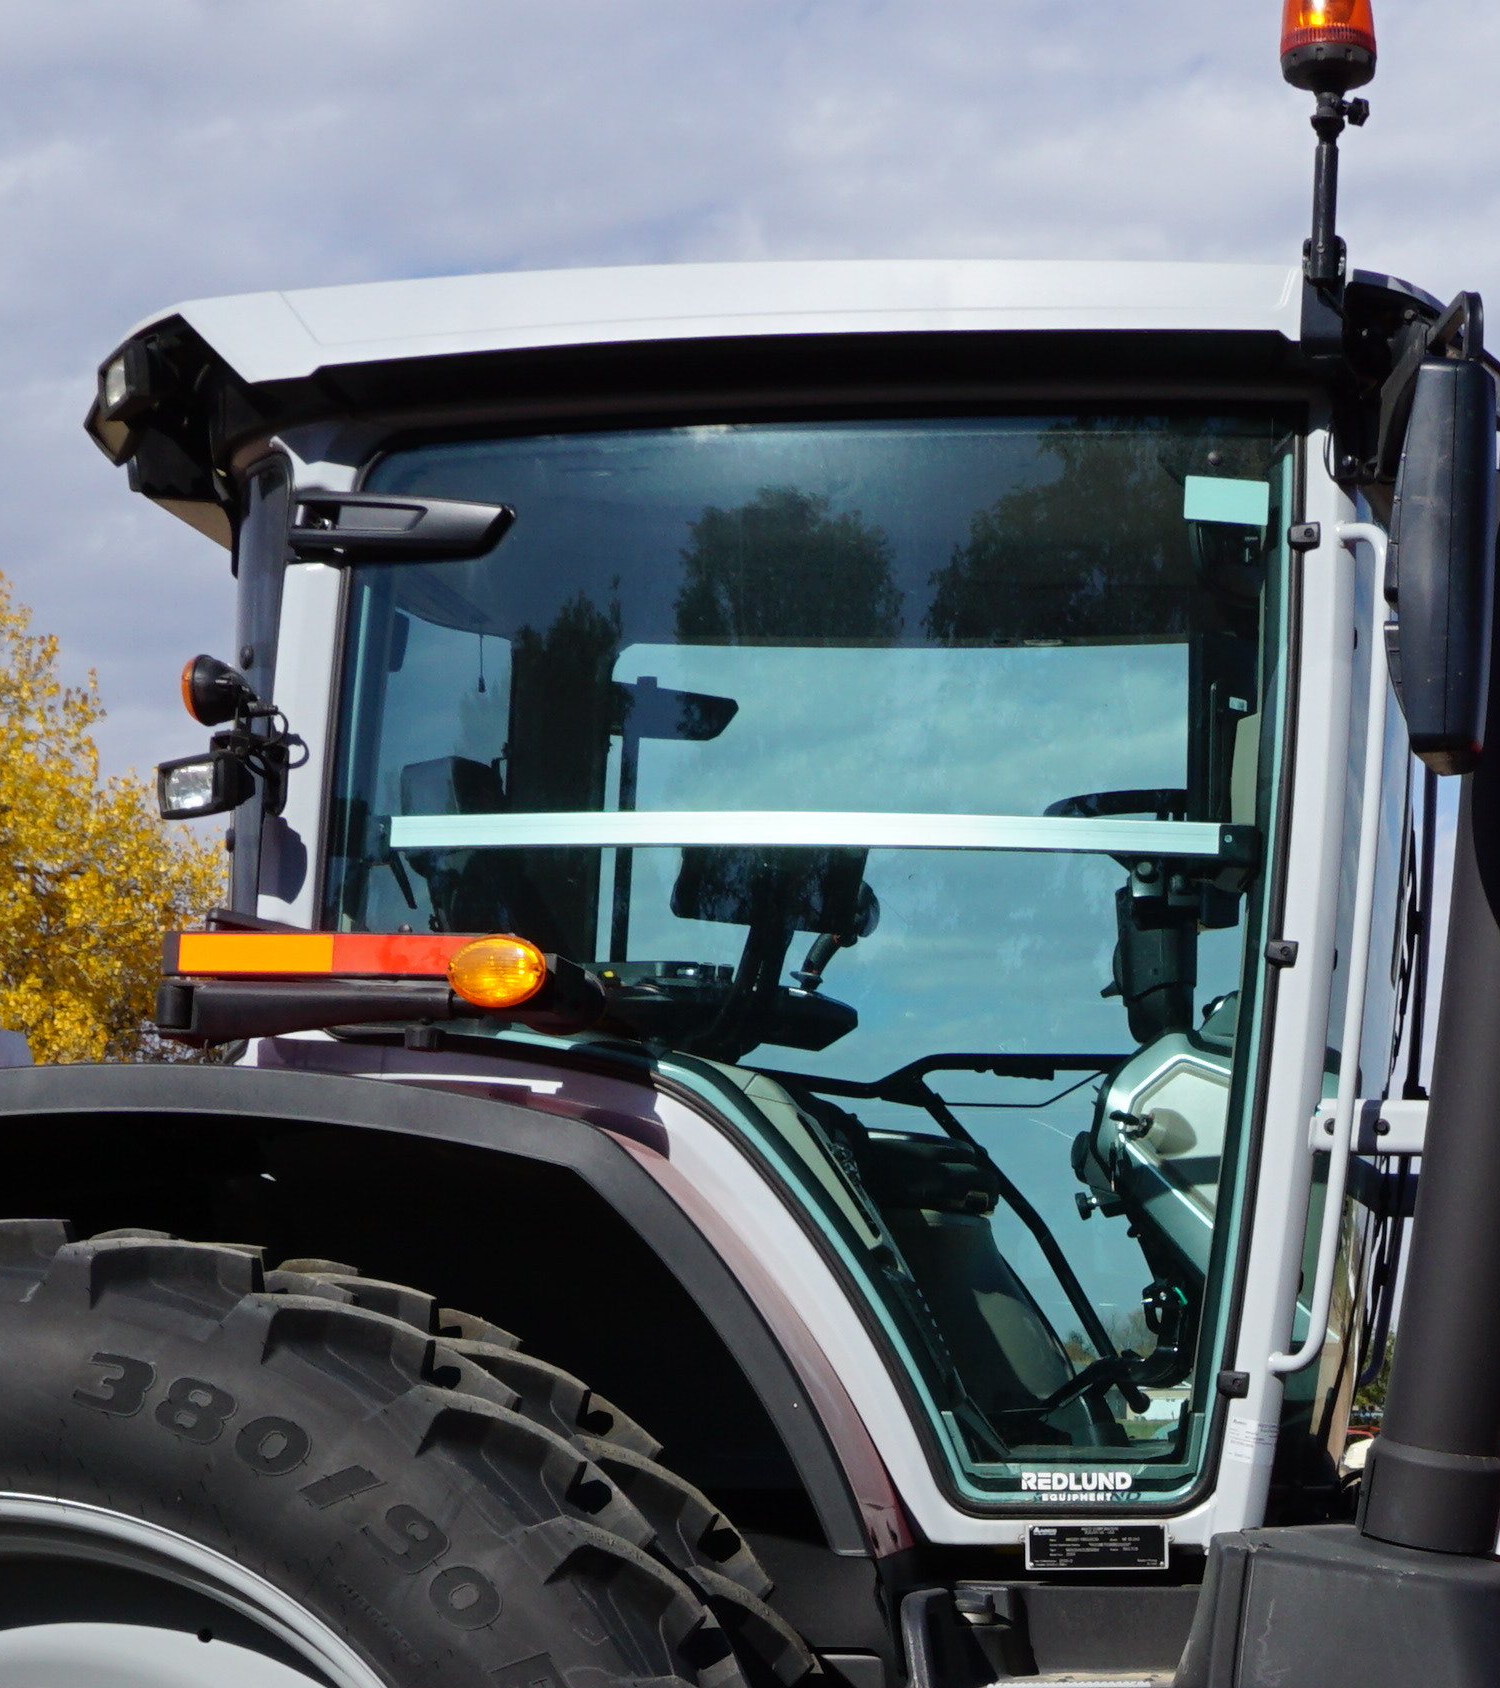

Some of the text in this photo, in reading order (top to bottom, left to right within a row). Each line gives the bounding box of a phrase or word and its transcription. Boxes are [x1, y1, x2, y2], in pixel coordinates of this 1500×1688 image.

[1022, 1471, 1132, 1490] REDLUND
[70, 1351, 505, 1631] 380/90
[1042, 1493, 1112, 1501] EQUIPMENT
